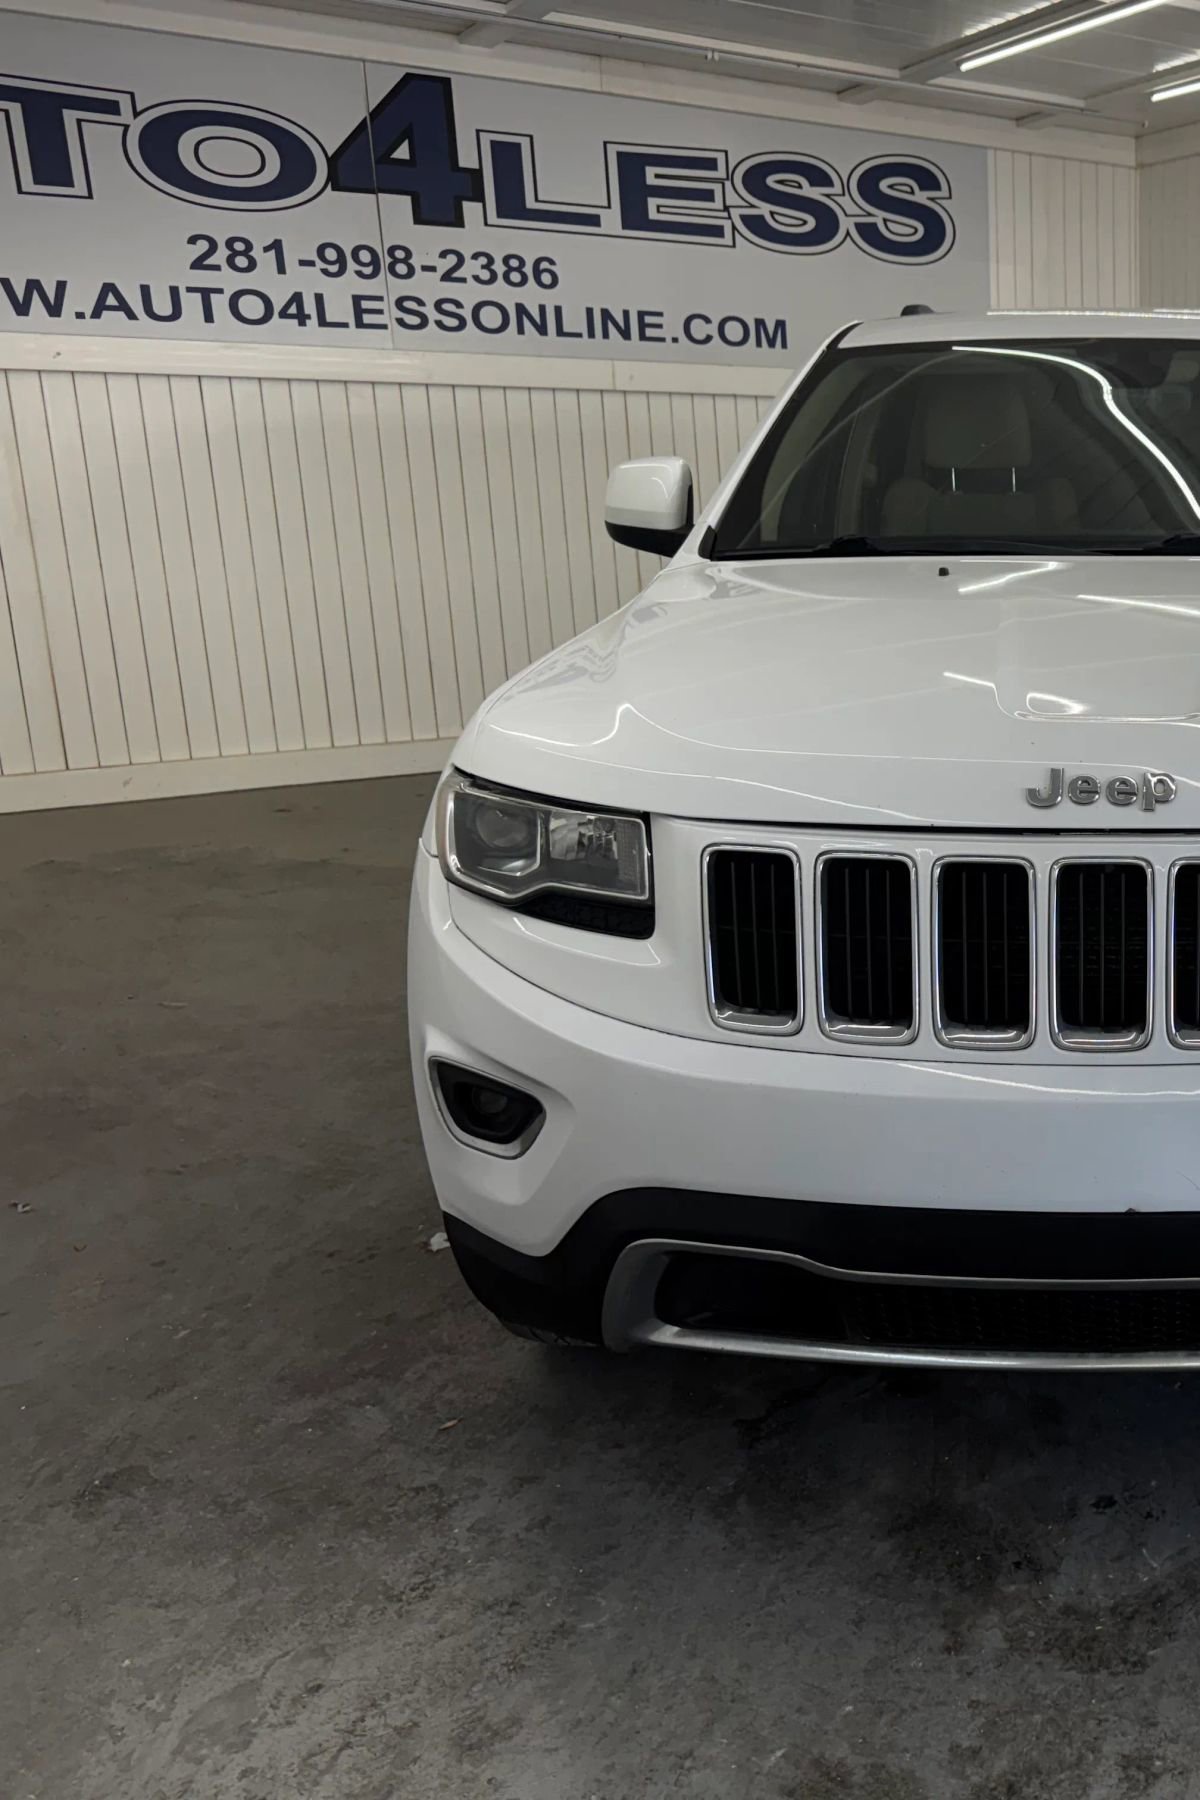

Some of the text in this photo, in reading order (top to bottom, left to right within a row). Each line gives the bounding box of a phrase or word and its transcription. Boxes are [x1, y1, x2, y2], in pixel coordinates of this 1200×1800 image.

[186, 234, 559, 290] 281-998-2386
[0, 277, 788, 349] W.AUTO4LESSONLINE.COM
[1025, 767, 1177, 812] Jeep
